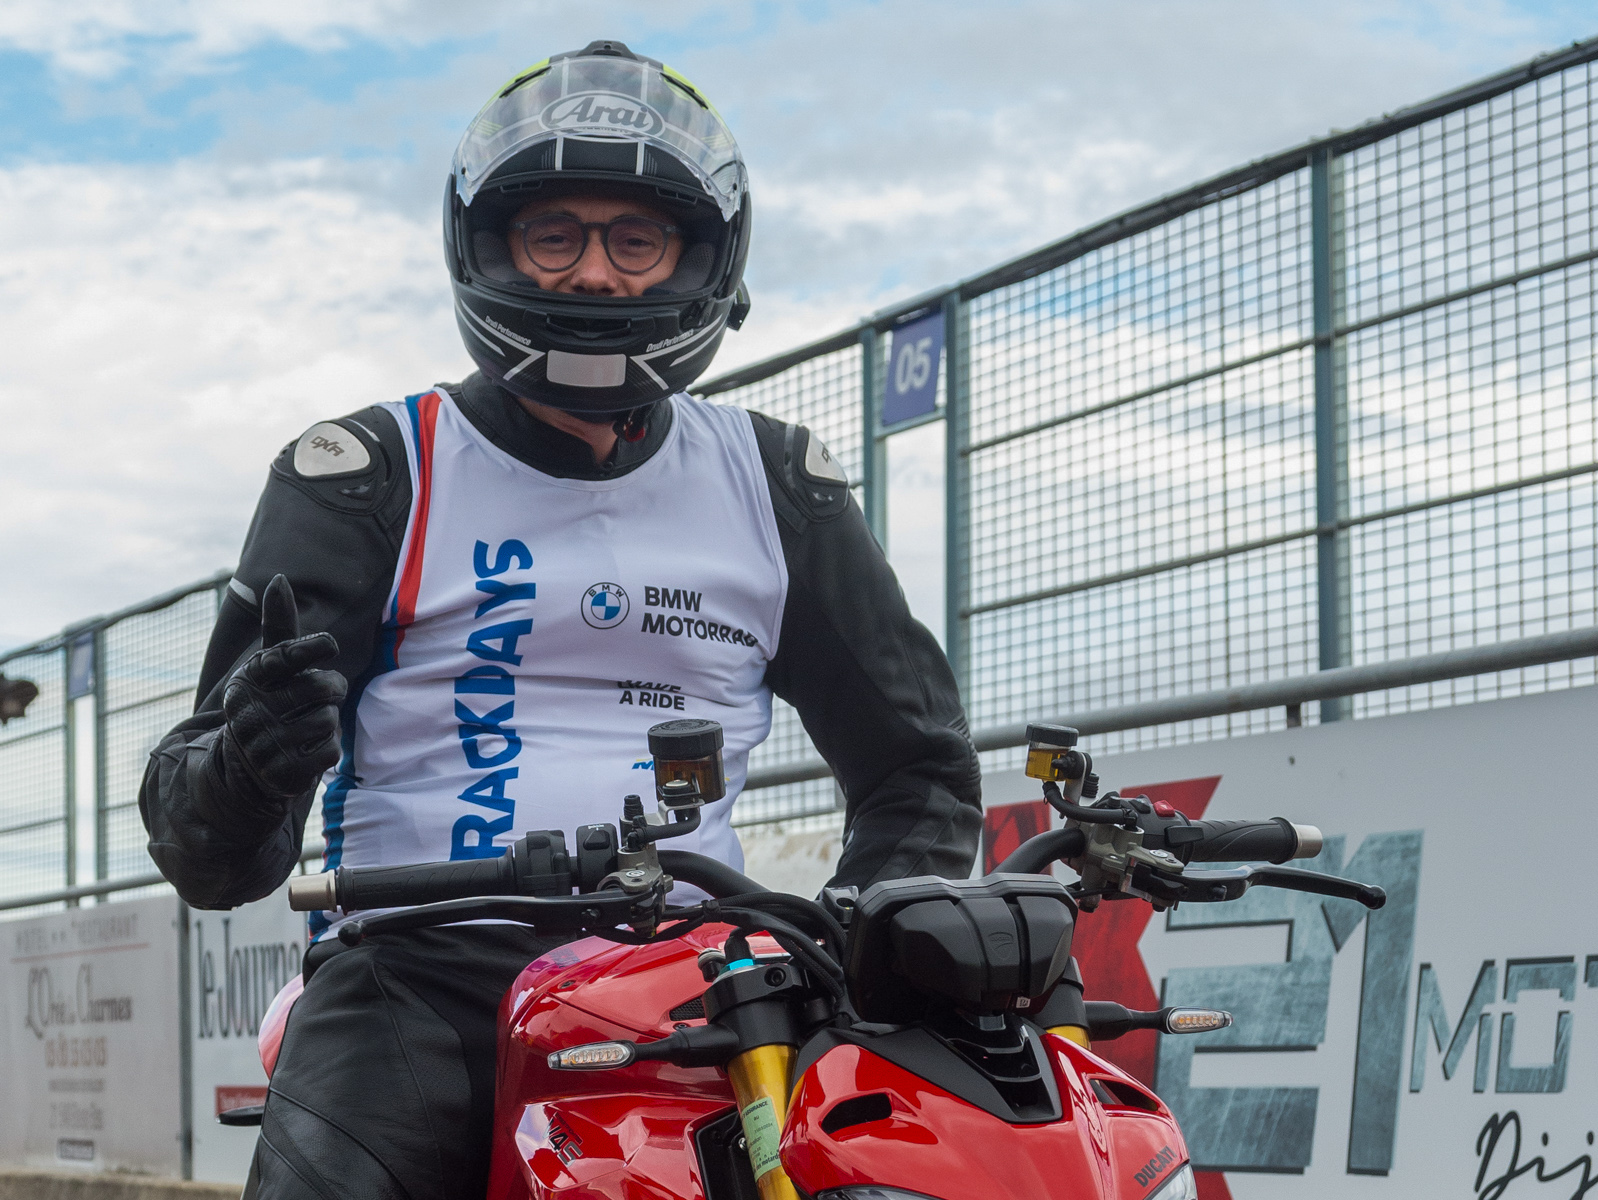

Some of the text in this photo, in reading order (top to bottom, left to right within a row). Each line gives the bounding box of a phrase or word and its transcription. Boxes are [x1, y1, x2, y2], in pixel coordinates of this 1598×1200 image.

[549, 97, 650, 129] Arai
[895, 337, 932, 395] 05
[588, 584, 624, 598] BMW
[644, 585, 702, 613] BMW
[640, 616, 758, 648] MOTORRAD
[449, 538, 537, 862] RACKDAYS
[619, 690, 686, 711] A RIDE
[1408, 954, 1598, 1094] MO
[1133, 1145, 1177, 1188] DUCATI
